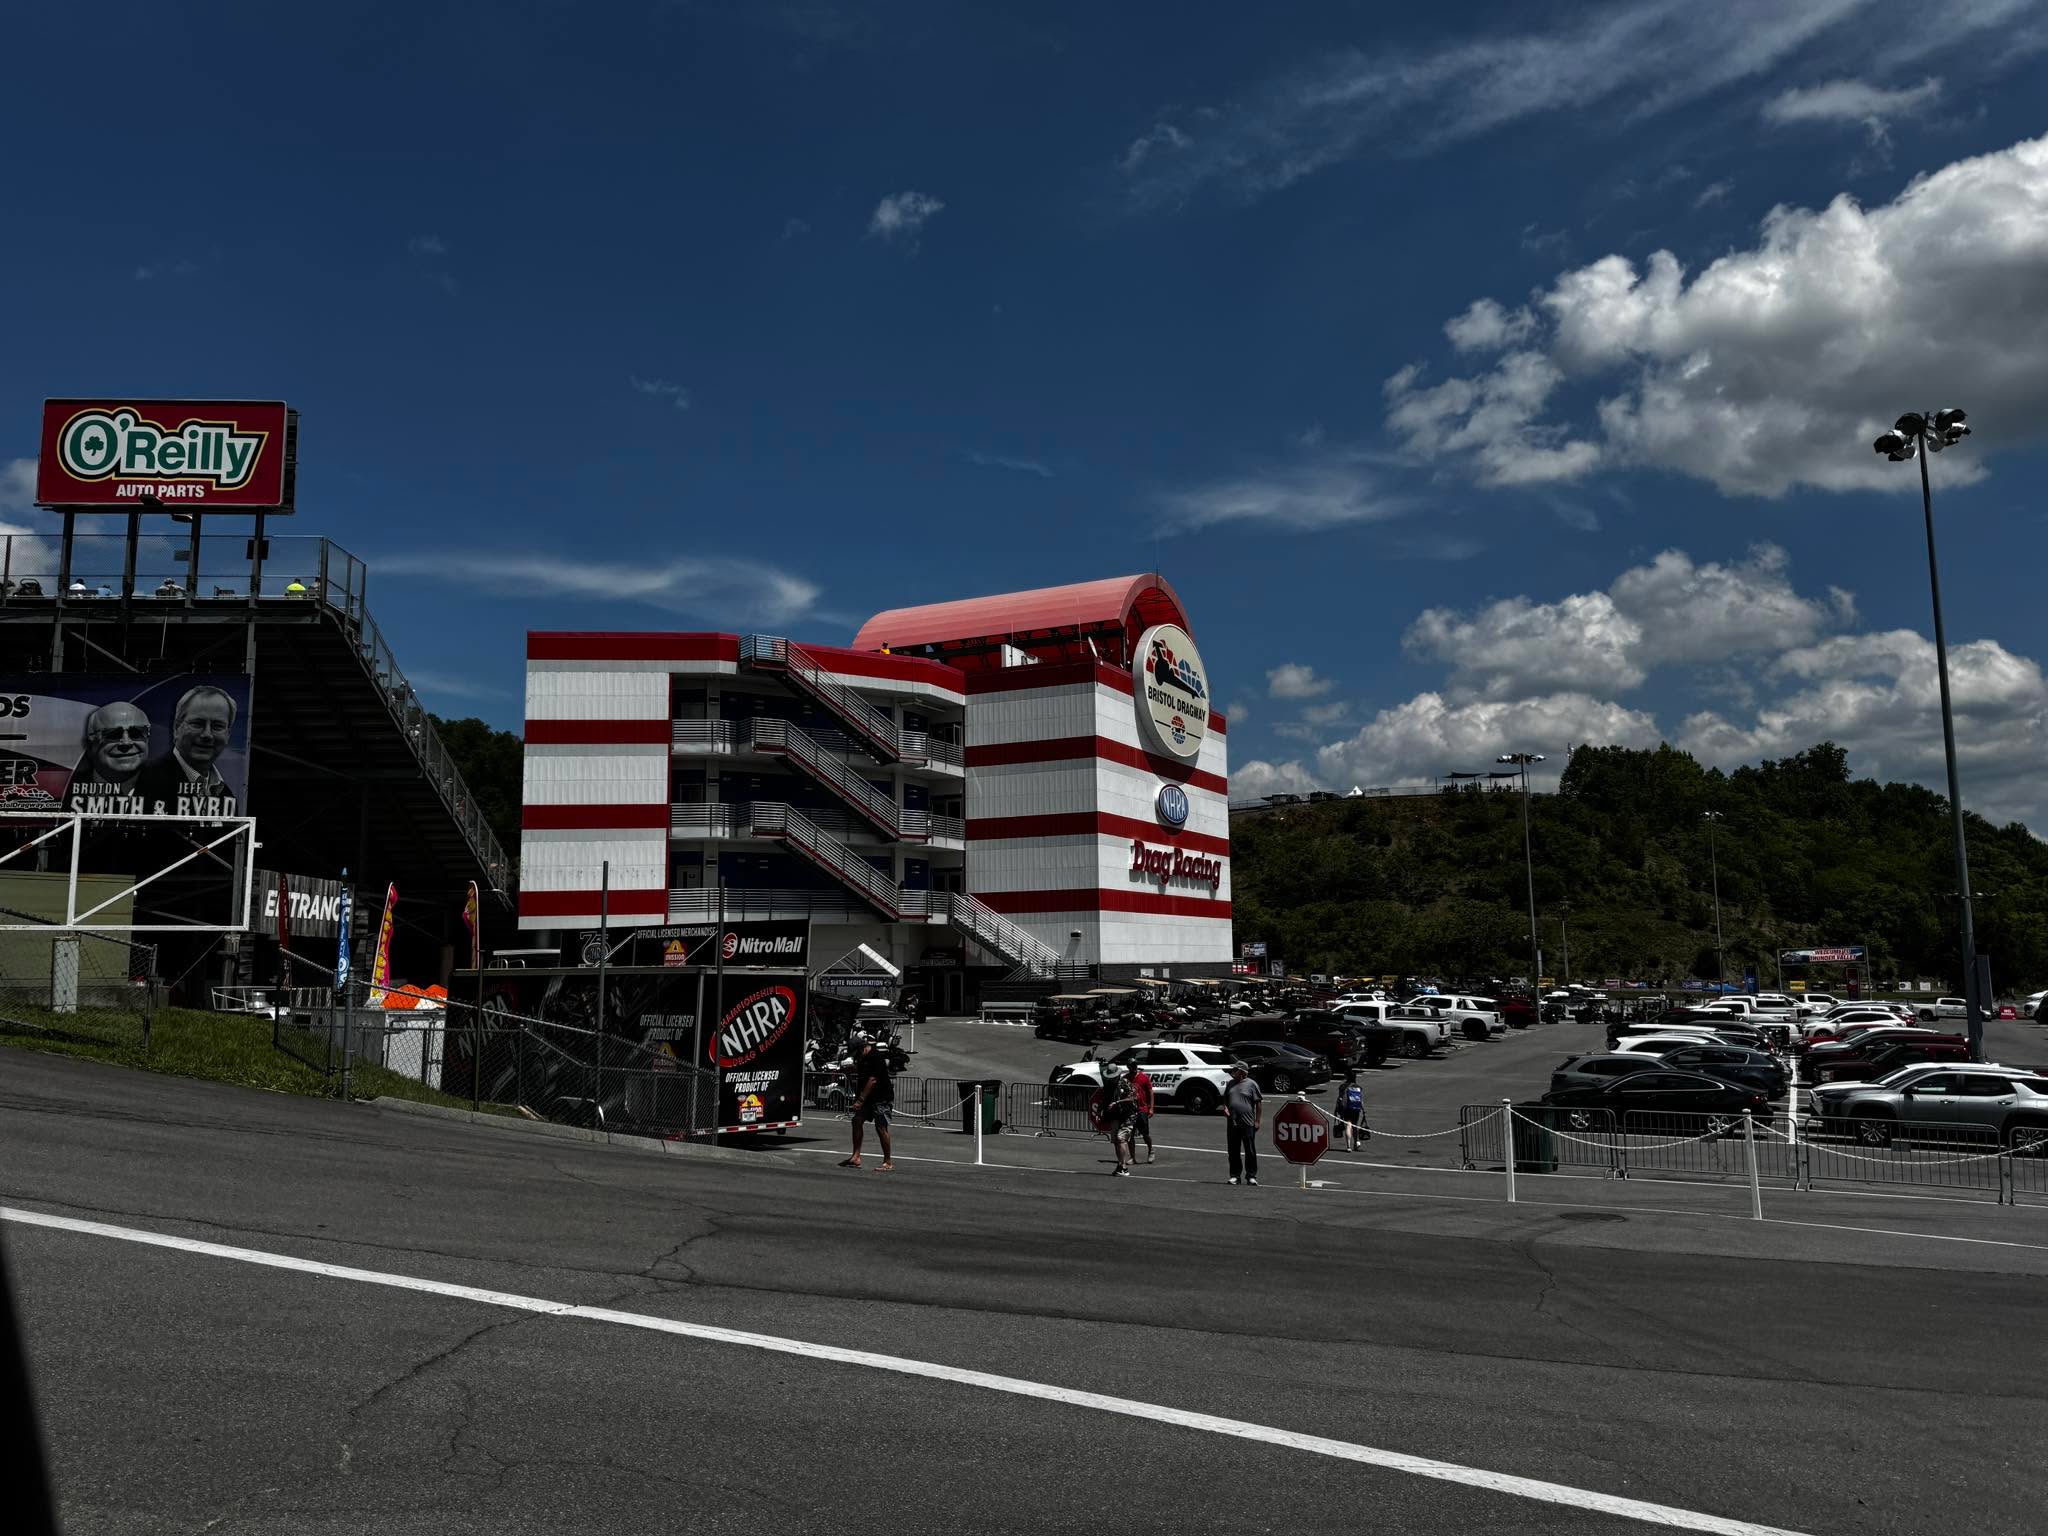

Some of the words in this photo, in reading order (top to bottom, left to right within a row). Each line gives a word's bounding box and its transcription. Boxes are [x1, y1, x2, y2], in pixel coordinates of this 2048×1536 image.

[70, 418, 252, 480] O'Reilly
[115, 484, 154, 497] AUTO
[158, 484, 205, 498] PARTS
[1148, 685, 1175, 710] BRISTOL
[1176, 698, 1206, 722] DRAGWAY
[72, 782, 121, 795] BRUTON
[178, 782, 203, 795] JEFF
[70, 795, 145, 817] SMITH
[1163, 789, 1187, 820] NHRA
[1132, 839, 1174, 885] Drag
[1173, 847, 1222, 890] Racing
[264, 889, 351, 922] ETRANC
[636, 928, 657, 939] OFFICIAL
[657, 927, 681, 939] LICENSED
[681, 926, 717, 938] MERCHANDISE
[830, 979, 846, 987] SUITE
[846, 979, 884, 987] REGISTRATION
[639, 1014, 665, 1027] OFFICIAL
[665, 1014, 695, 1028] LICENSED
[721, 996, 786, 1057] NHRA
[758, 1021, 789, 1053] RACING
[733, 1049, 757, 1067] DRAG
[725, 1071, 751, 1083] OFFICIAL
[751, 1070, 780, 1082] LICENSED
[1148, 1074, 1182, 1083] RIFF
[734, 1081, 760, 1093] PRODUCT
[761, 1080, 770, 1092] OF
[1278, 1121, 1325, 1143] STOP
